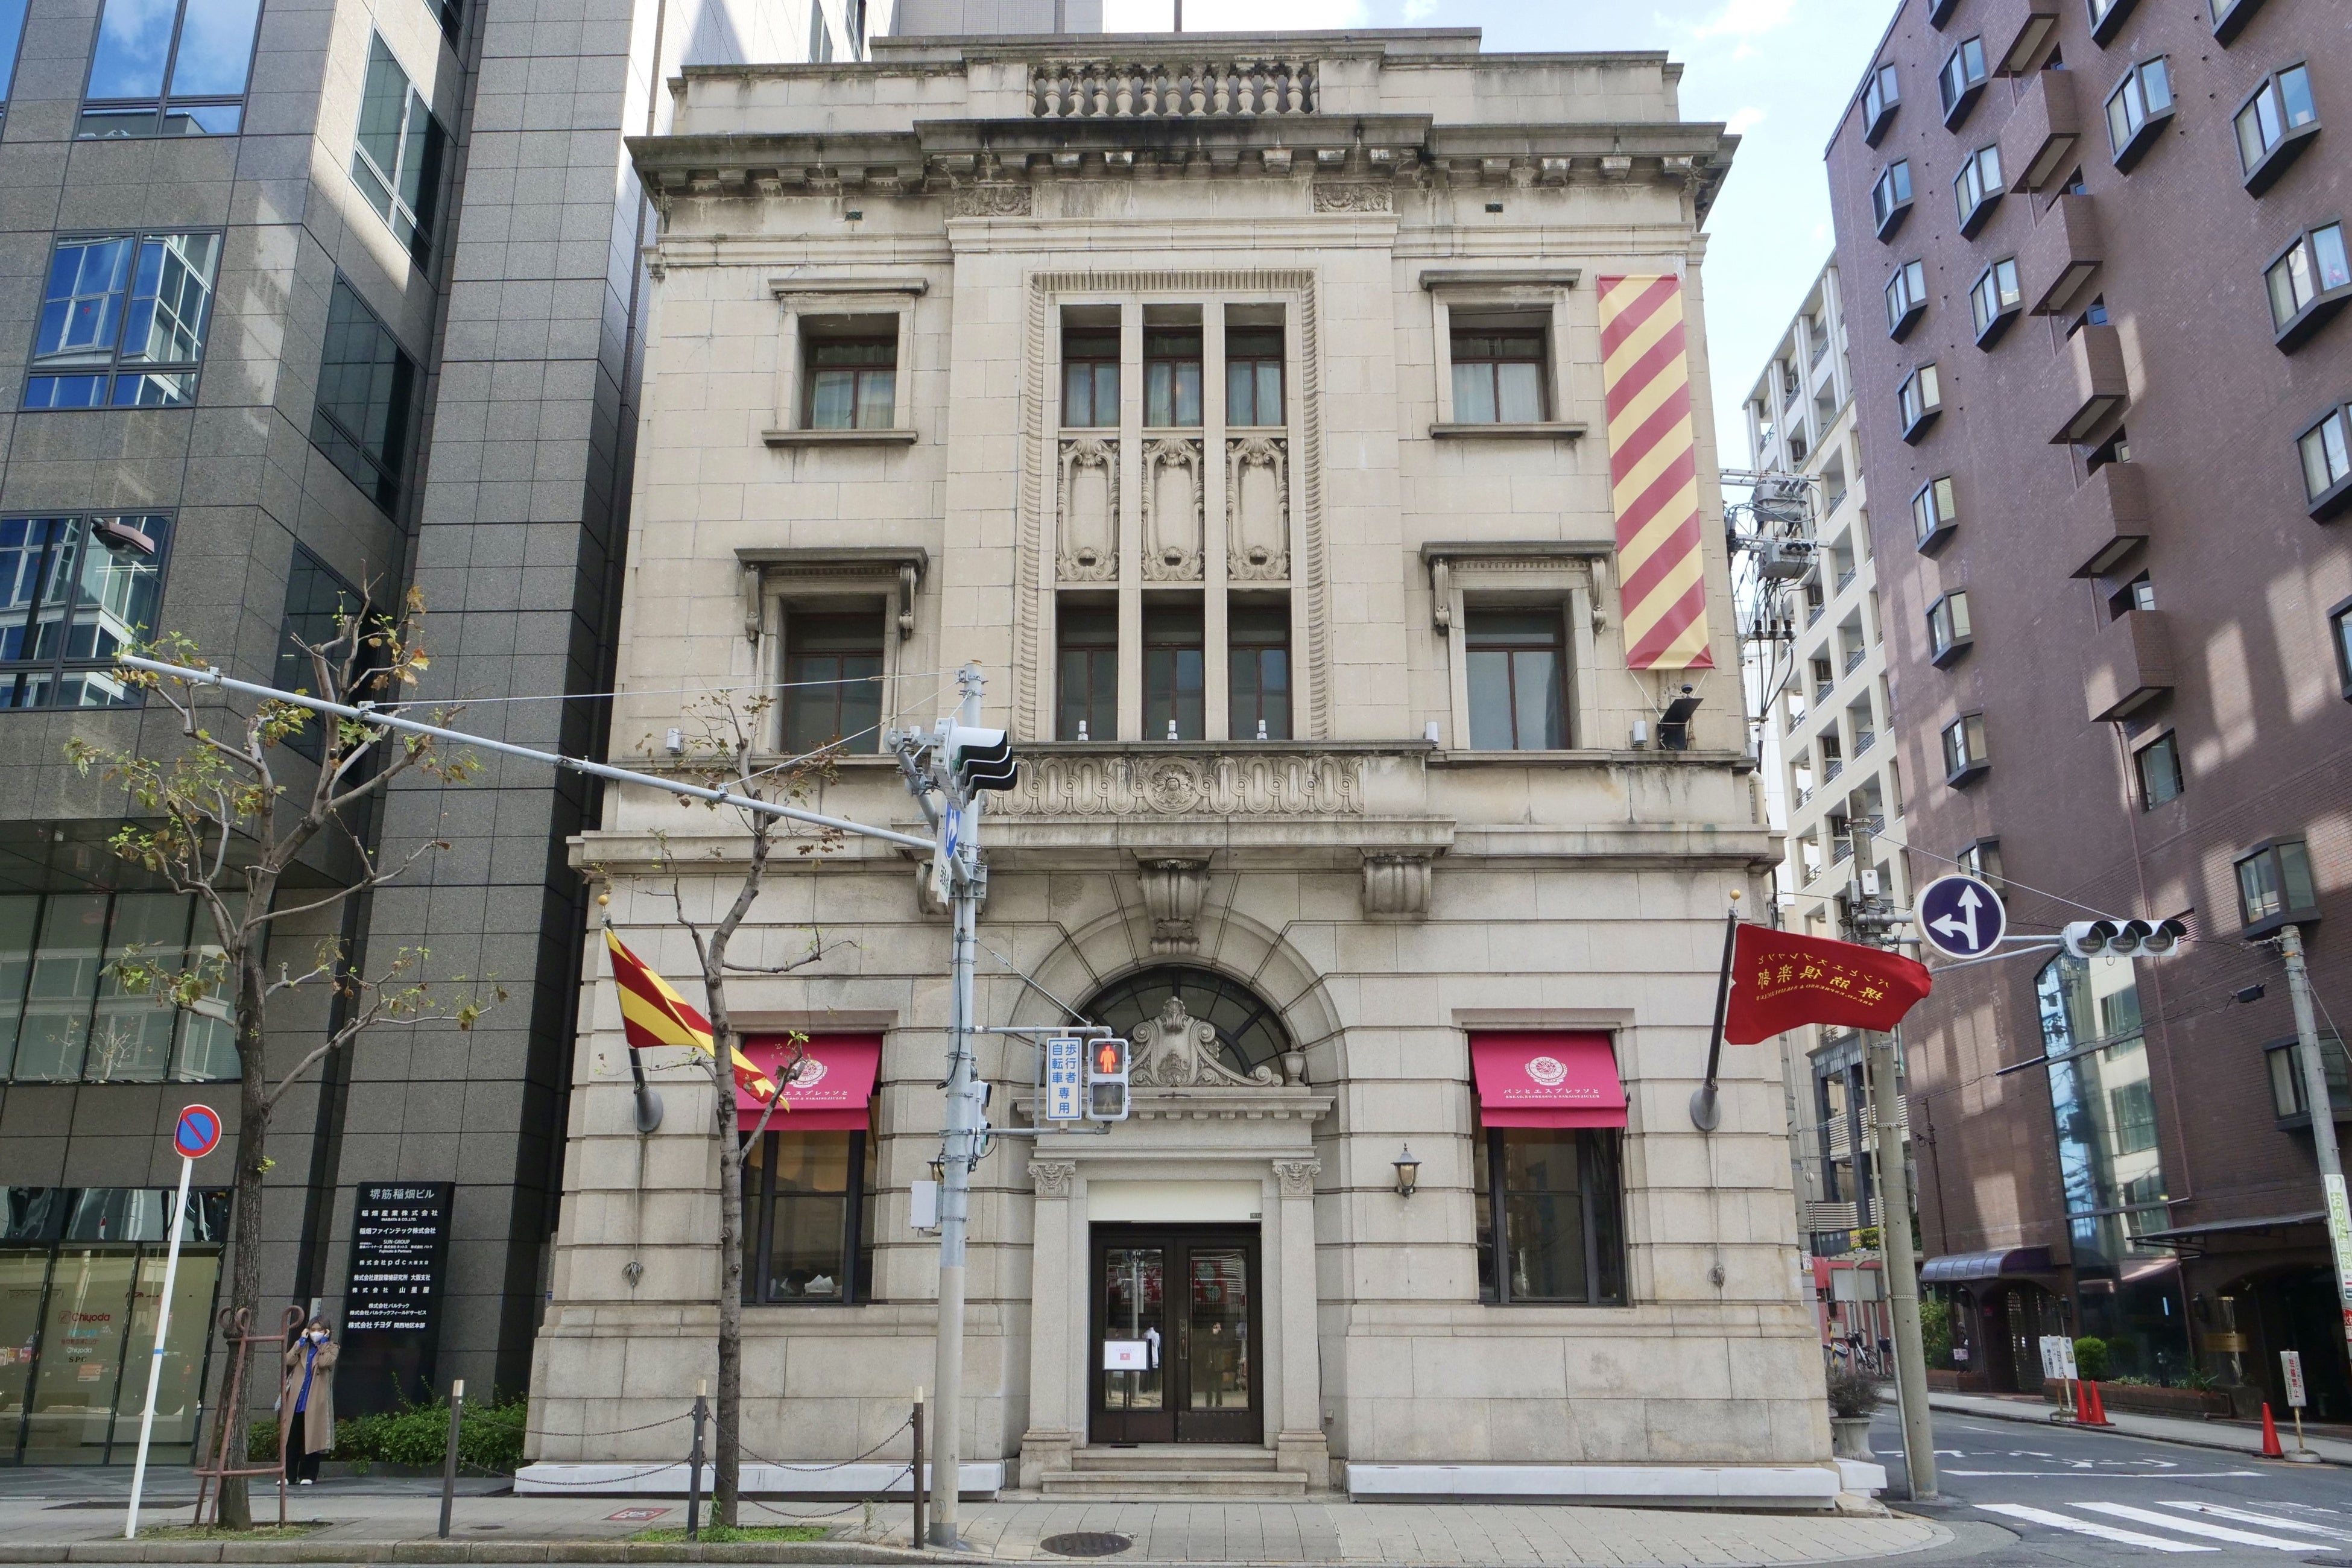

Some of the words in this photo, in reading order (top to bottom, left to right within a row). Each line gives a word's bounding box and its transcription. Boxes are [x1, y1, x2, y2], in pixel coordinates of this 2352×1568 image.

[1051, 1043, 1063, 1084] 自転車
[1065, 1043, 1076, 1083] 歩行者
[1058, 1087, 1070, 1114] 専用
[369, 1188, 435, 1200] 堺筋稲畑ビル
